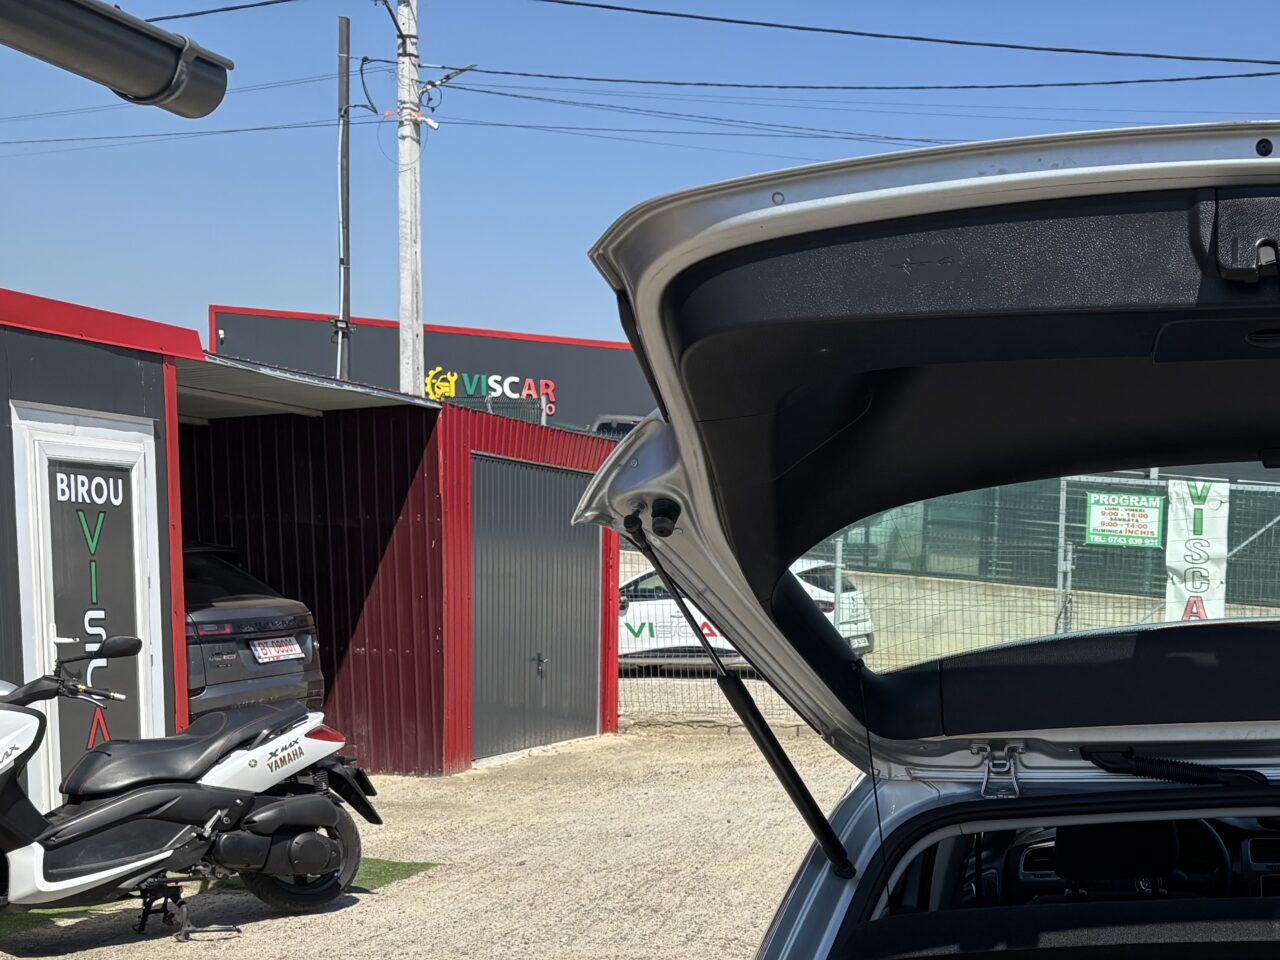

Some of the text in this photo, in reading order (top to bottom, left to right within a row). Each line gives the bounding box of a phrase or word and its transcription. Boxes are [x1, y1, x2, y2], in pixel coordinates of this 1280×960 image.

[462, 373, 556, 403] VISCAR
[56, 472, 124, 506] BIROU
[1090, 494, 1160, 507] PROGRAM
[267, 746, 305, 773] YAMAHA
